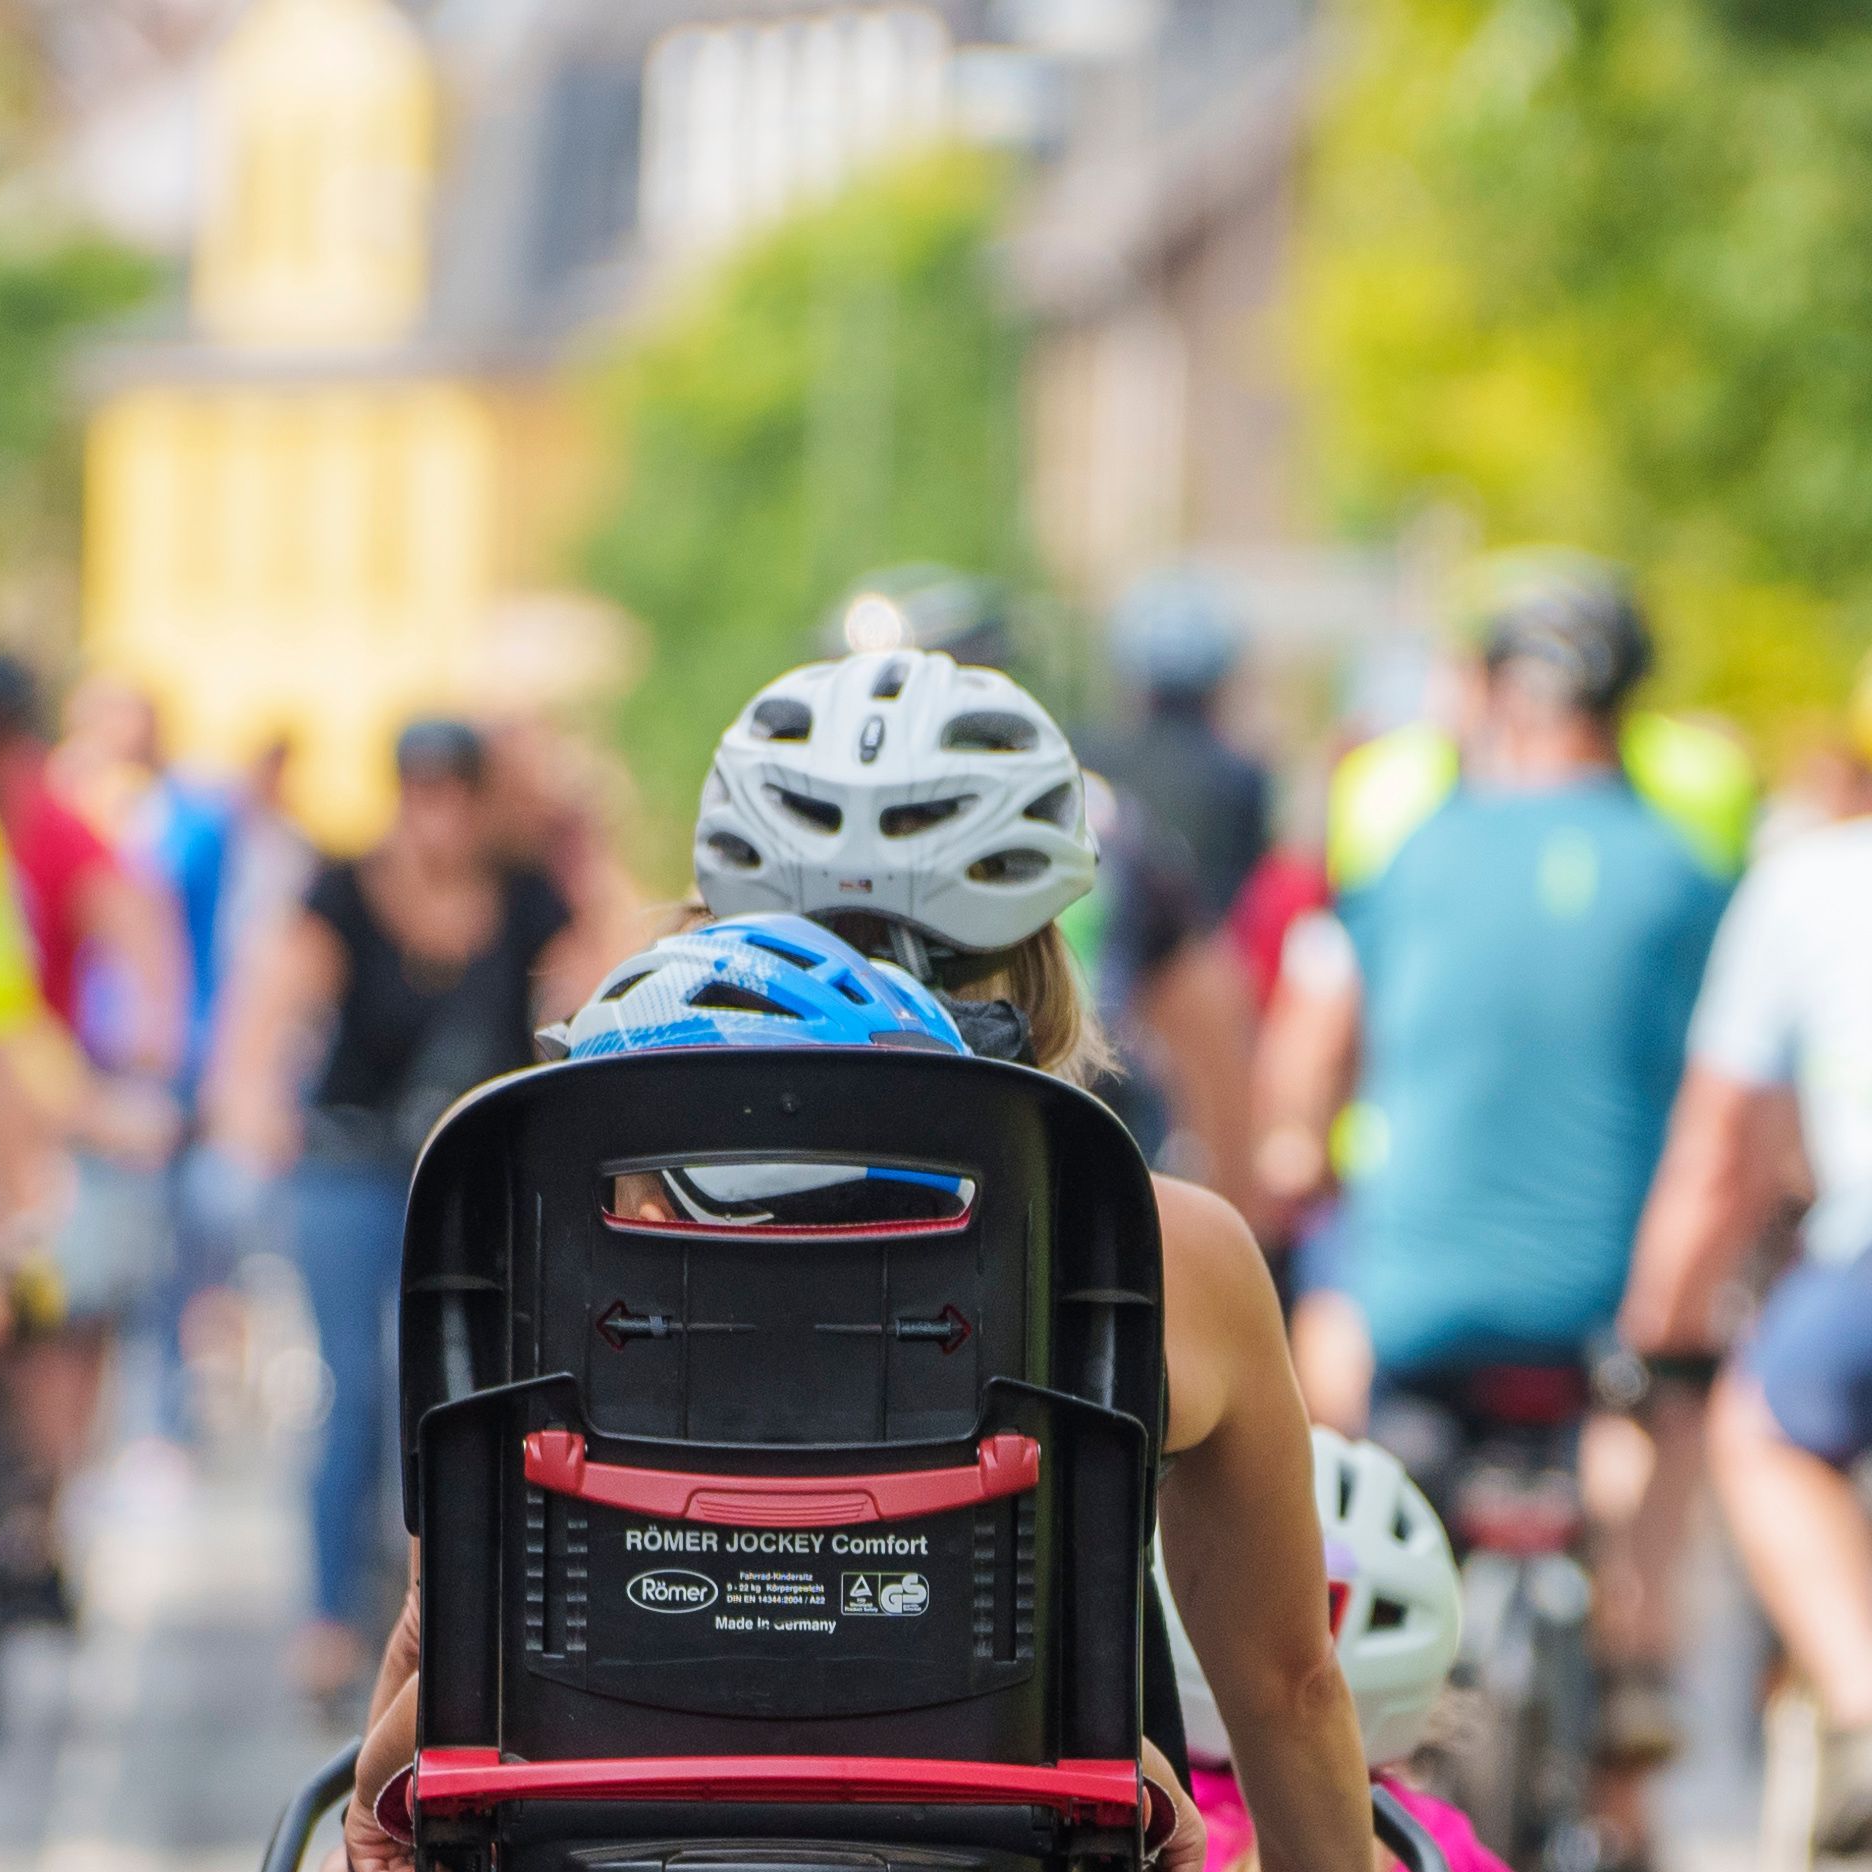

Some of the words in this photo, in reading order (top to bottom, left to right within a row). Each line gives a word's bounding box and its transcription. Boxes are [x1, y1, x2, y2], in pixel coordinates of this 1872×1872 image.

[625, 1523, 718, 1552] RÖMER
[725, 1532, 825, 1553] JOCKEY
[831, 1534, 928, 1555] Comfort
[641, 1578, 708, 1602] Römer
[726, 1595, 742, 1604] DIN
[743, 1595, 756, 1604] EN
[715, 1616, 753, 1631] Made
